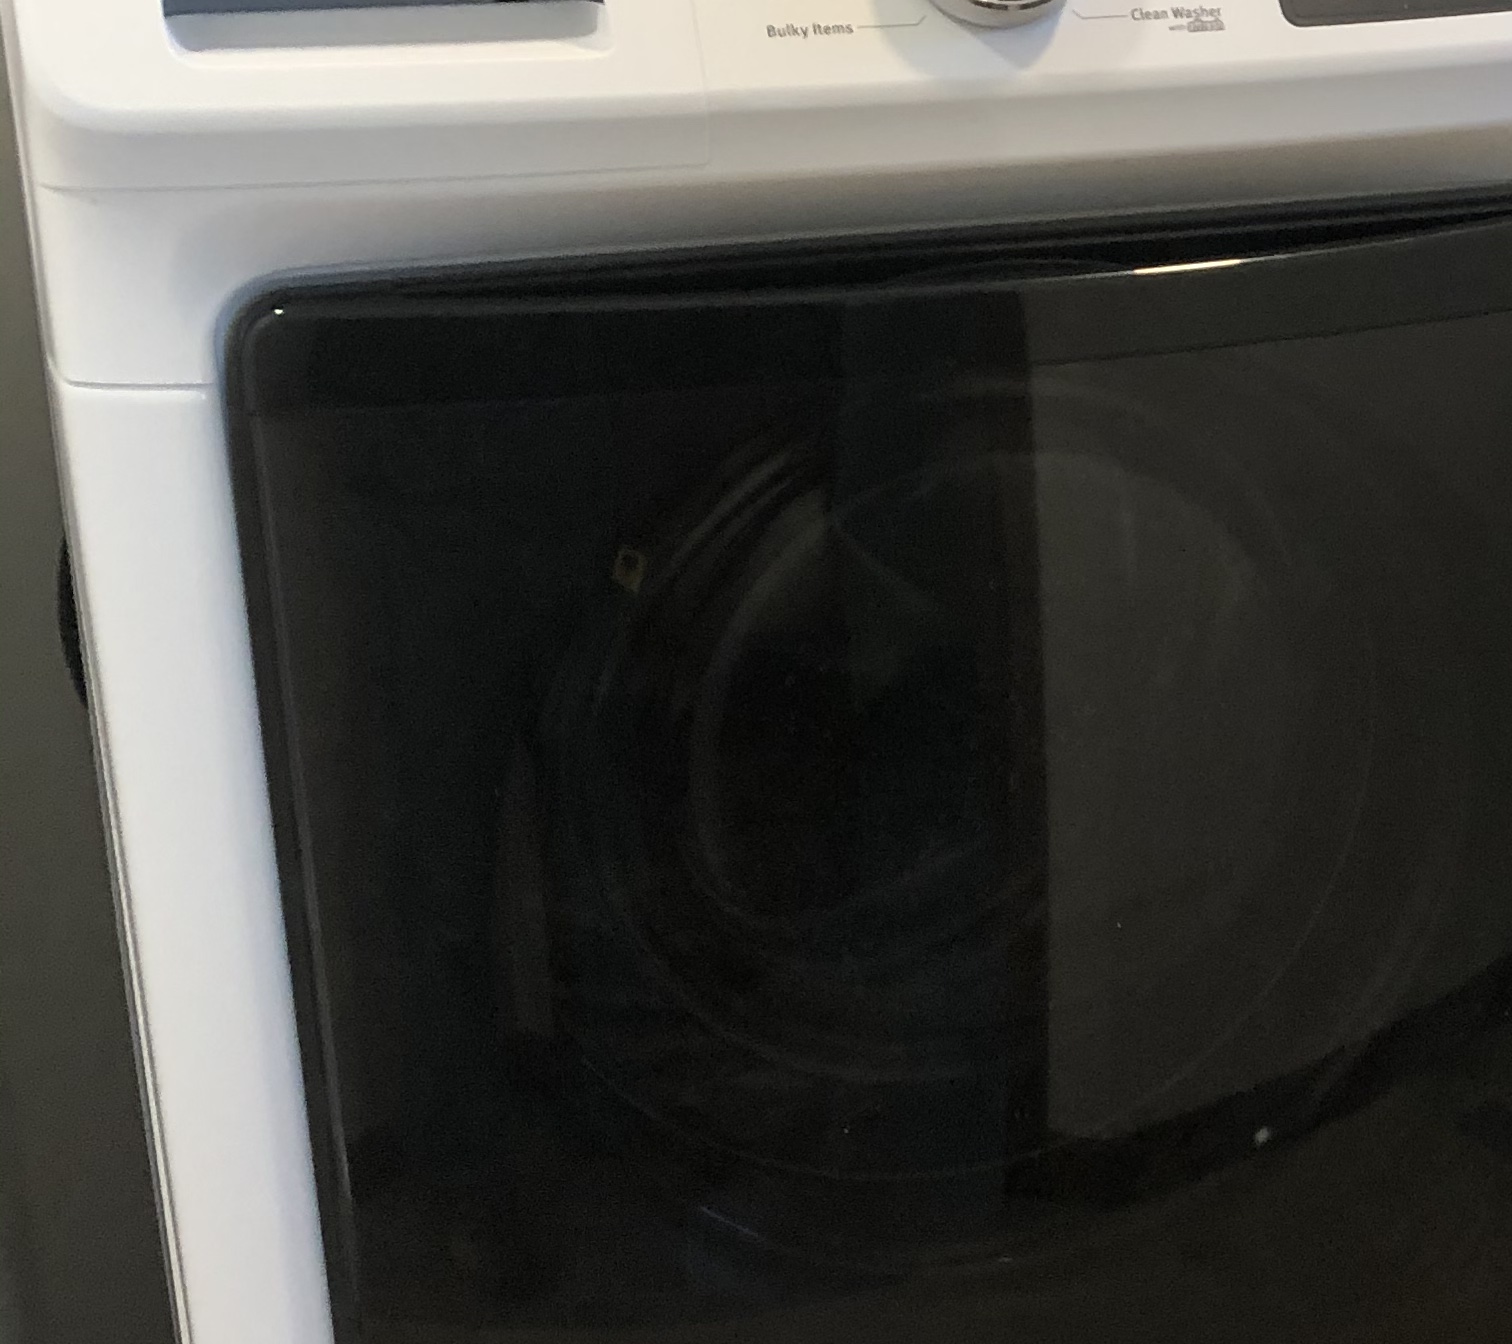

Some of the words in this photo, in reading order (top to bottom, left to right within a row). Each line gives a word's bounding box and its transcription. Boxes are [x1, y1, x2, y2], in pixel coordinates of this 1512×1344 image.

[1131, 8, 1169, 21] Clean
[1170, 6, 1222, 19] Washer
[766, 23, 808, 39] Bulky
[812, 23, 854, 36] Items
